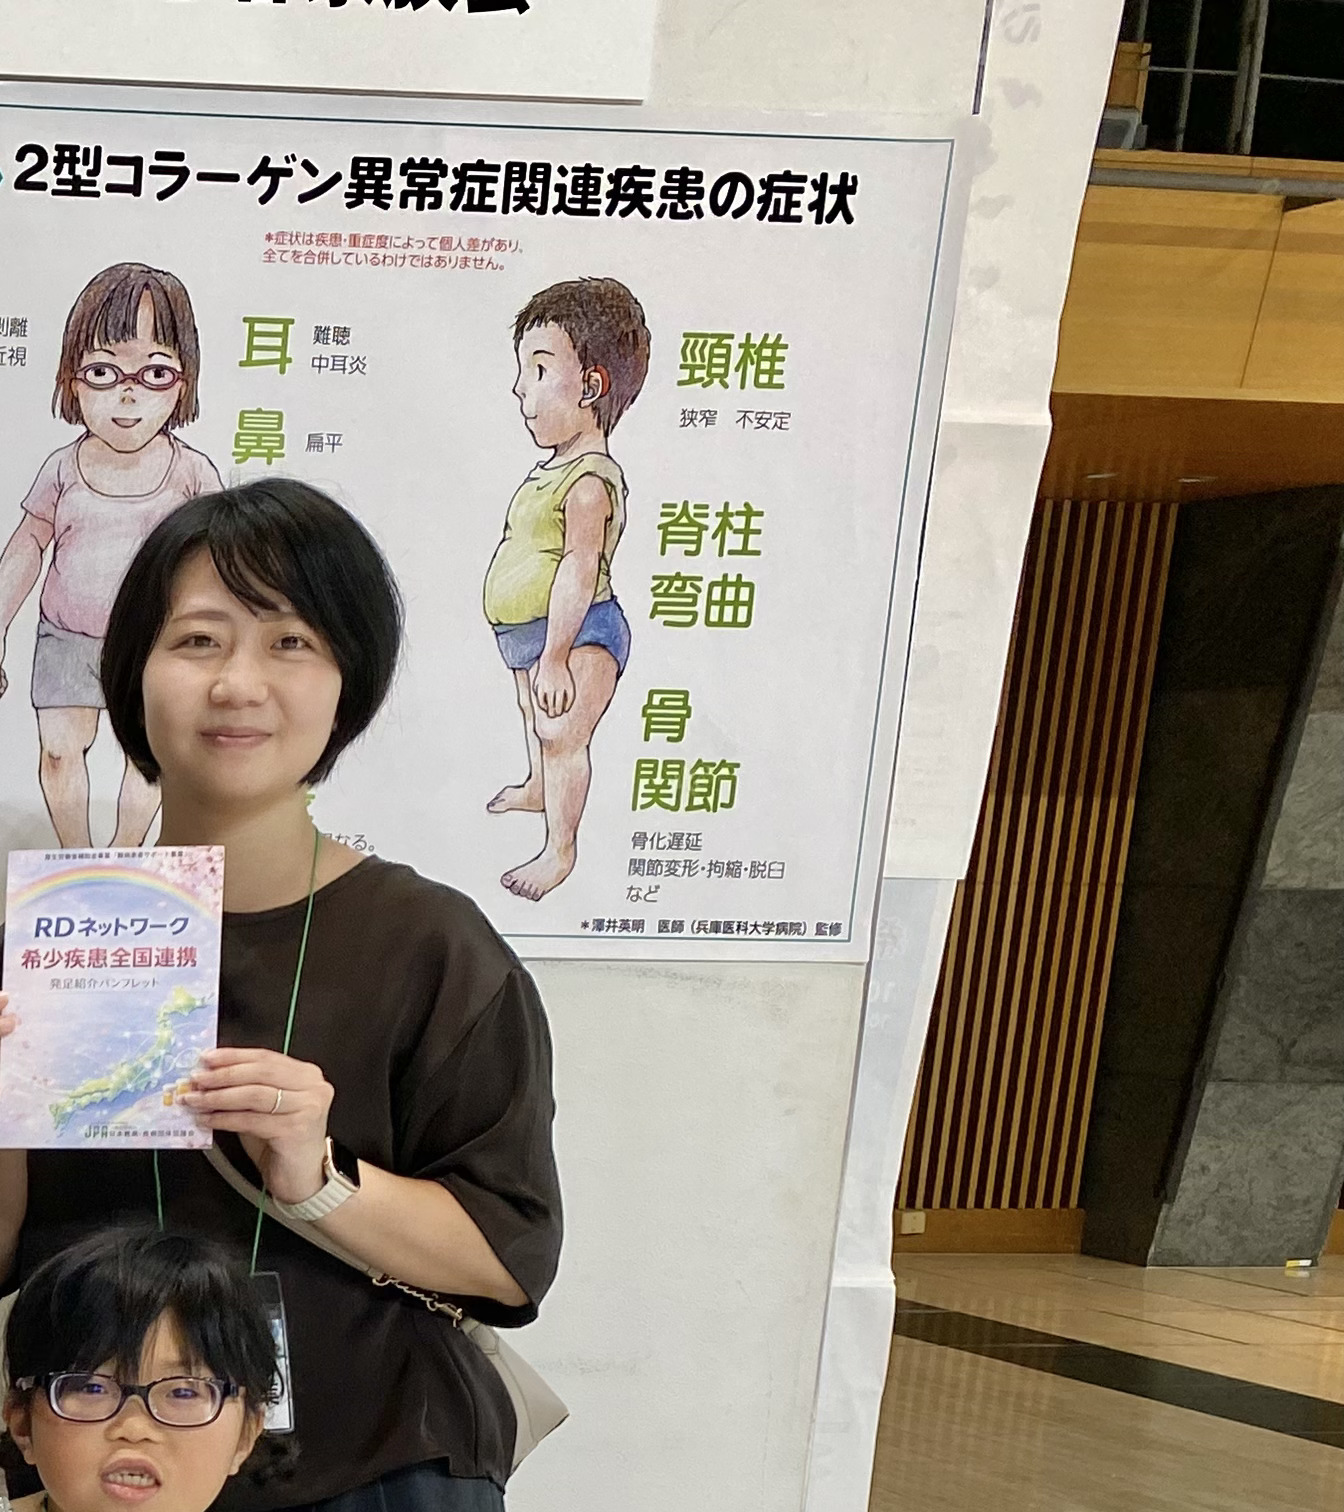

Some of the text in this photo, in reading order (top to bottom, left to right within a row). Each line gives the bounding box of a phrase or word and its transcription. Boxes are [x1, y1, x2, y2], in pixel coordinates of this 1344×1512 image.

[14, 143, 858, 227] 2型コラーゲン異常症関連疾患の症状
[262, 248, 506, 272] 全てを合併しているわけではありません。
[238, 316, 352, 376] 耳 難聴
[310, 354, 367, 376] 中耳炎
[679, 407, 792, 432] 狭窄 不安定
[231, 408, 344, 466] 鼻 扁平
[656, 500, 765, 559] 脊柱
[648, 572, 757, 630] 弯曲
[641, 689, 692, 744] 骨
[630, 758, 741, 814] 関節
[630, 832, 703, 853] 骨化遅延
[627, 858, 786, 880] 関節変形・拘縮・脱臼
[625, 884, 660, 904] など
[34, 917, 190, 938] RDネットワーク
[21, 946, 198, 970] 希少疾患全国連携
